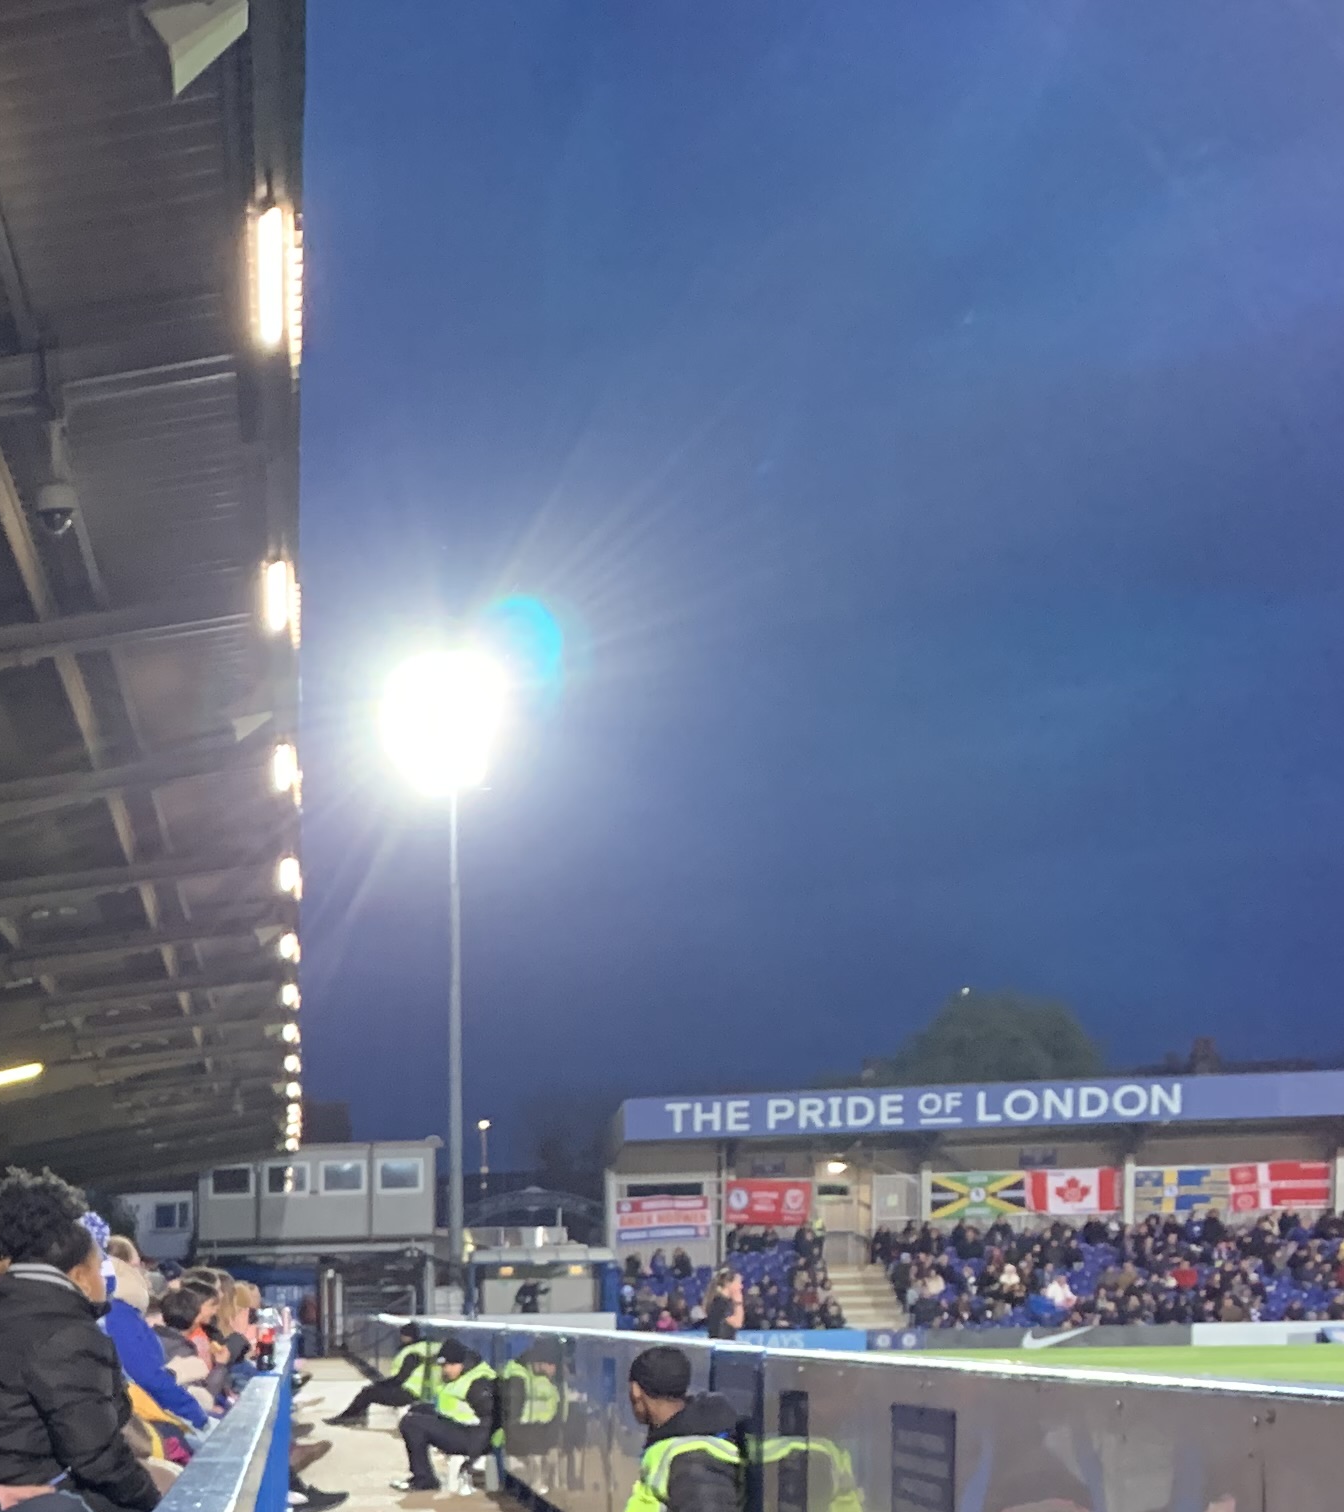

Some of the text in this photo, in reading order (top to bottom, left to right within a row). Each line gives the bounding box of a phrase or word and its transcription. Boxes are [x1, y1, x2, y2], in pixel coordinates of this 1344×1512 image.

[665, 1083, 1182, 1133] THE PRIDE OF LONDON
